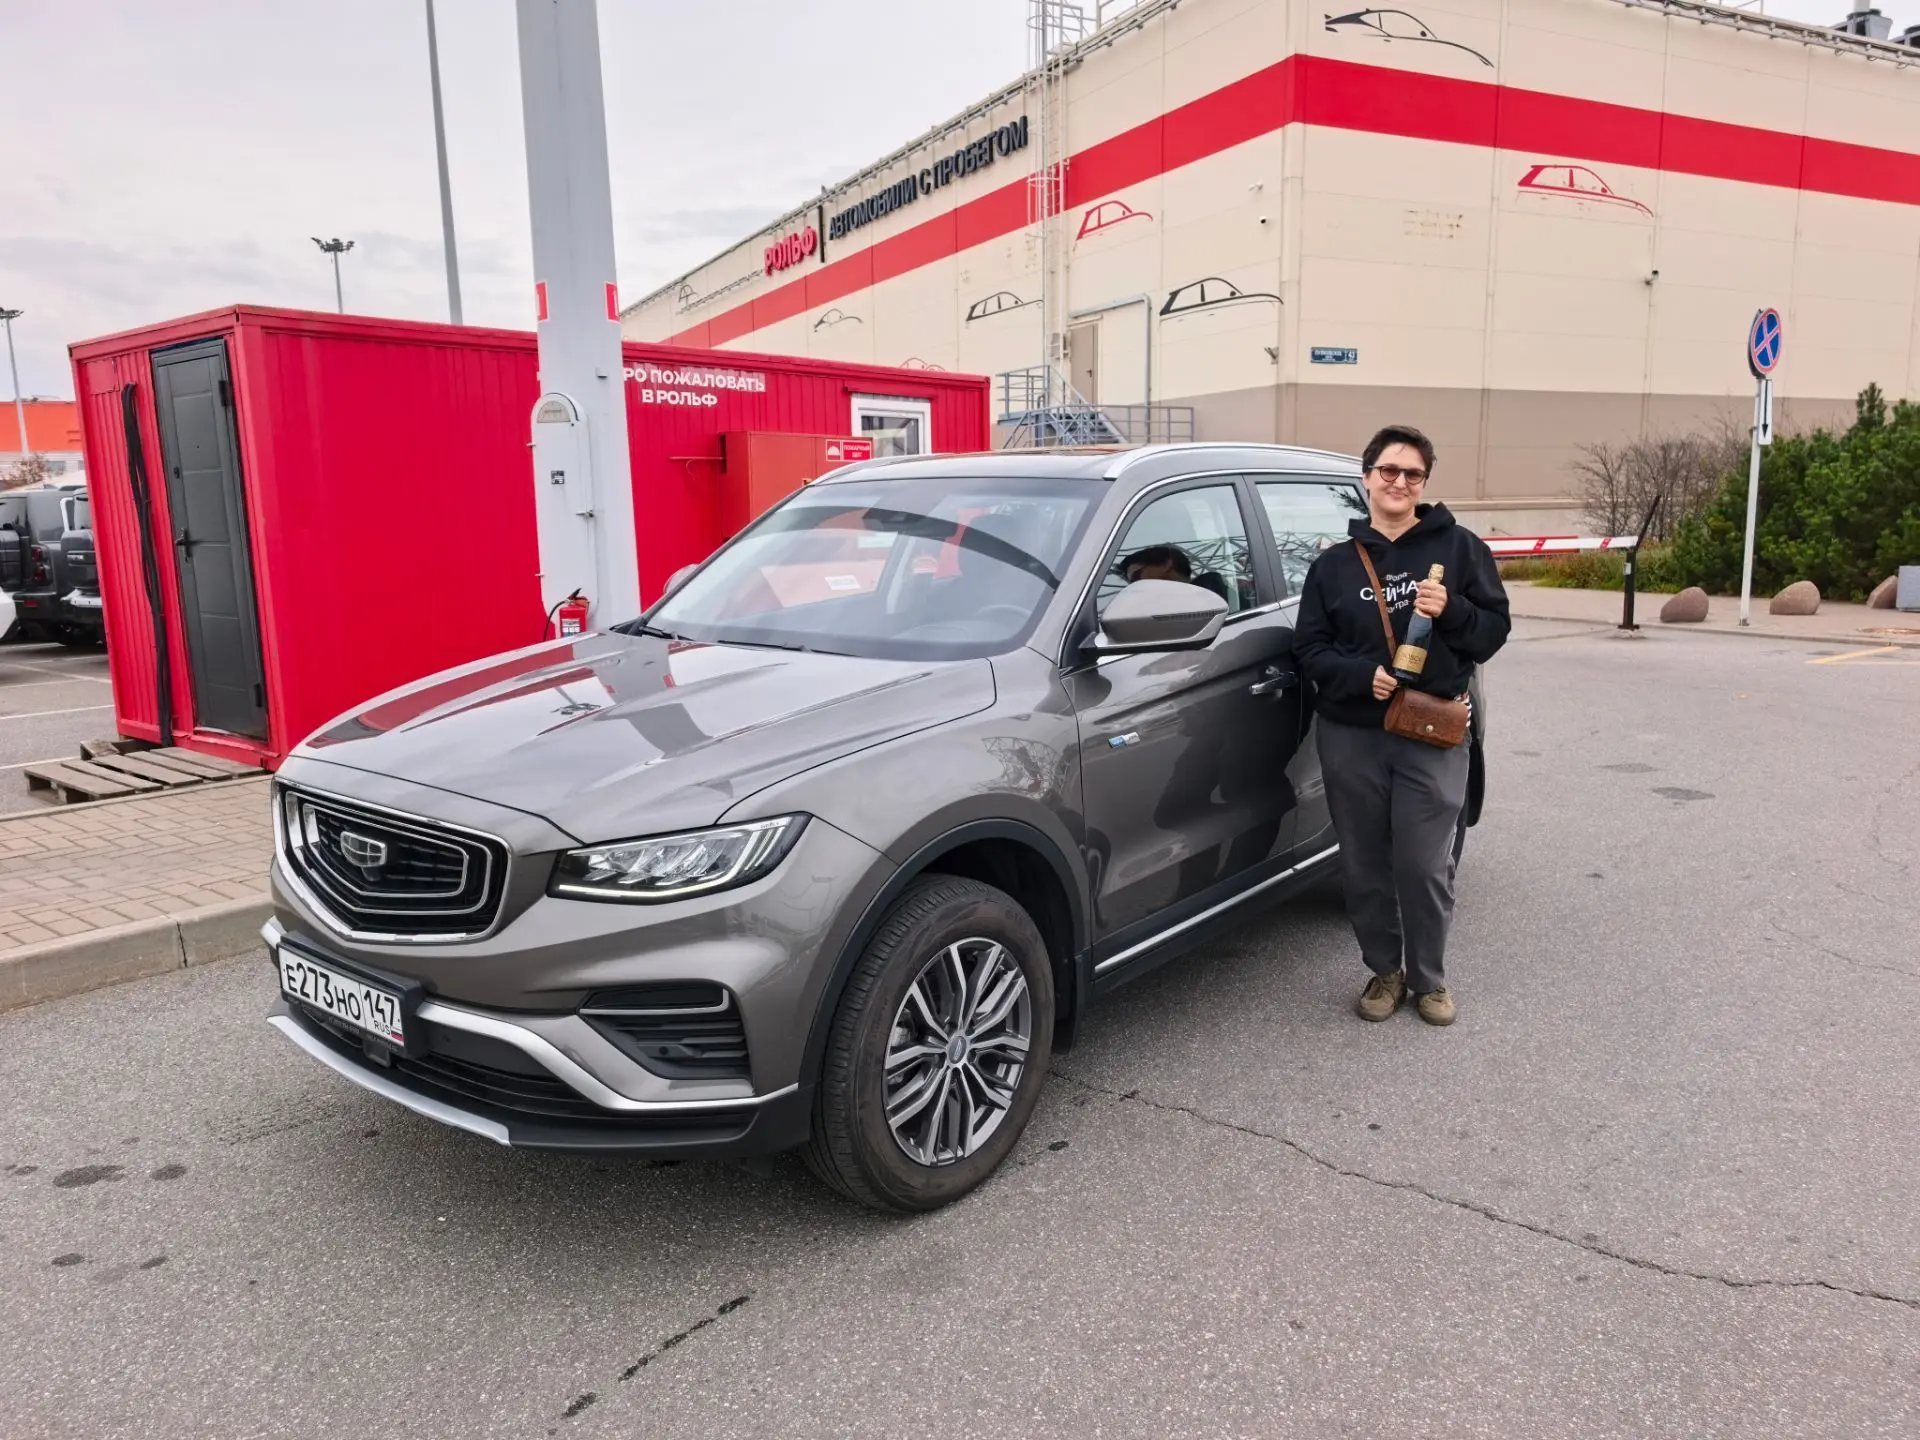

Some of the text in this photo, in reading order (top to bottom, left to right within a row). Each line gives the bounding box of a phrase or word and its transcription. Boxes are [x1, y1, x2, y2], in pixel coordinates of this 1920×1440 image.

[829, 115, 1029, 241] АВТОМОБИЛИ С ПРОБЕГОМ
[764, 225, 817, 276] РОЛЬФ
[623, 367, 765, 392] РО ПОЖАЛОВАТЬ
[642, 389, 718, 407] В РОЛЬФ
[1360, 579, 1419, 602] СЕЙЧА
[363, 989, 395, 1027] 147
[374, 1020, 392, 1035] RUS
